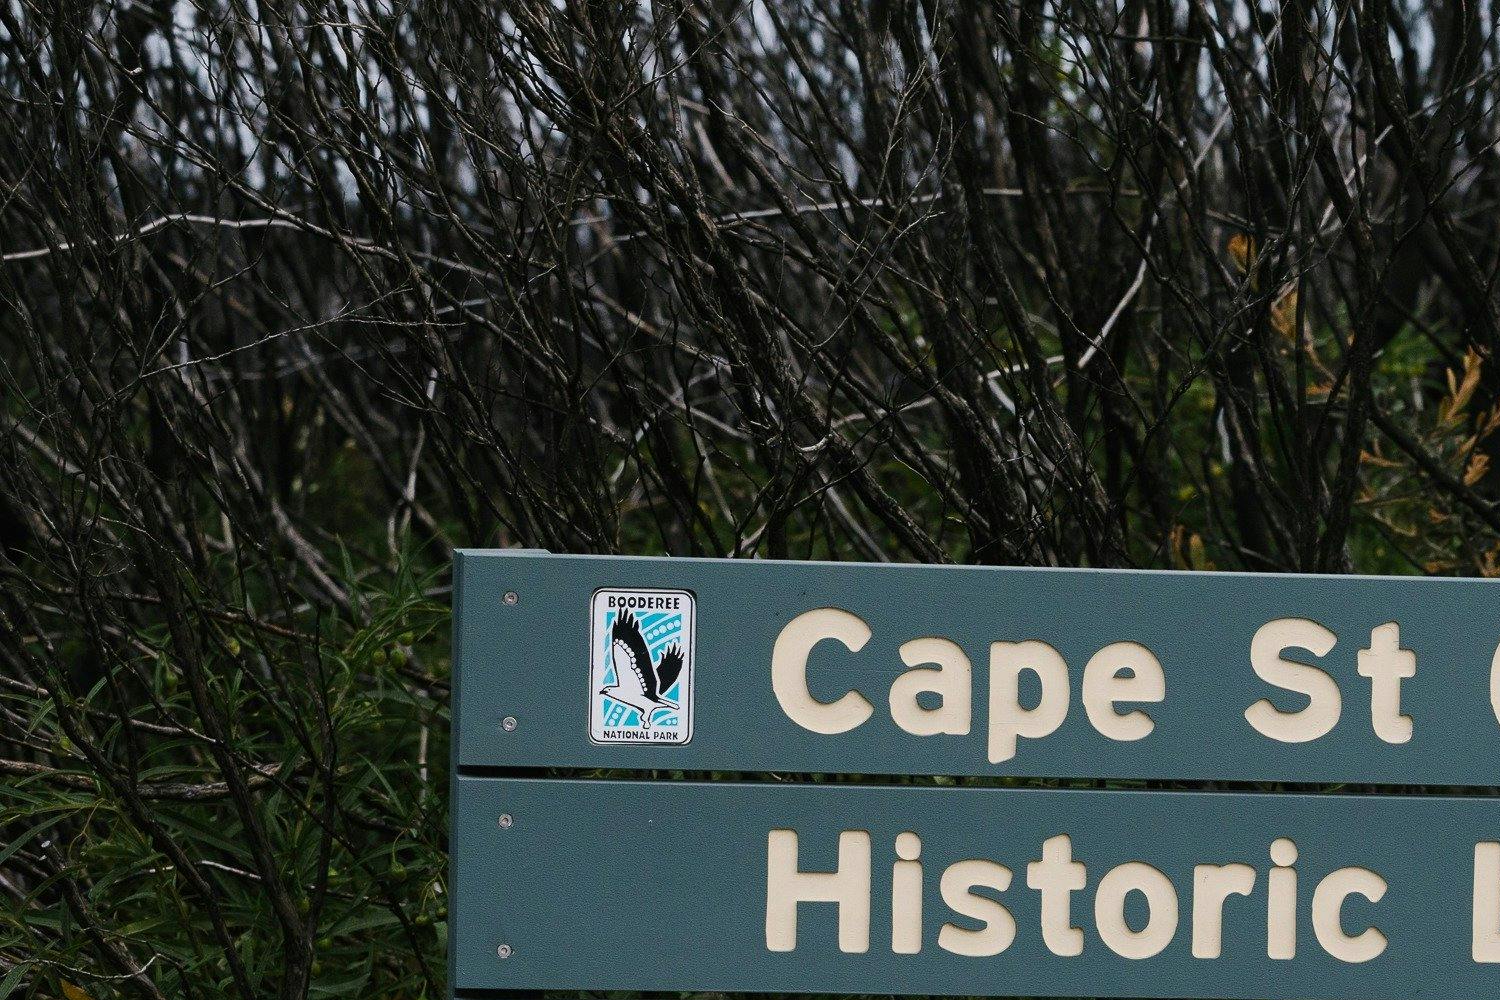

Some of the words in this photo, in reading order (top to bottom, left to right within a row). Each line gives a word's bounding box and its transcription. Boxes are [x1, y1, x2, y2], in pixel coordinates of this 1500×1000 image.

[608, 596, 680, 610] BOODEREE
[770, 607, 1167, 765] Cape
[1243, 617, 1417, 745] St
[603, 730, 650, 740] NATIONAL
[653, 731, 678, 740] PARK
[764, 828, 1389, 964] Historic
